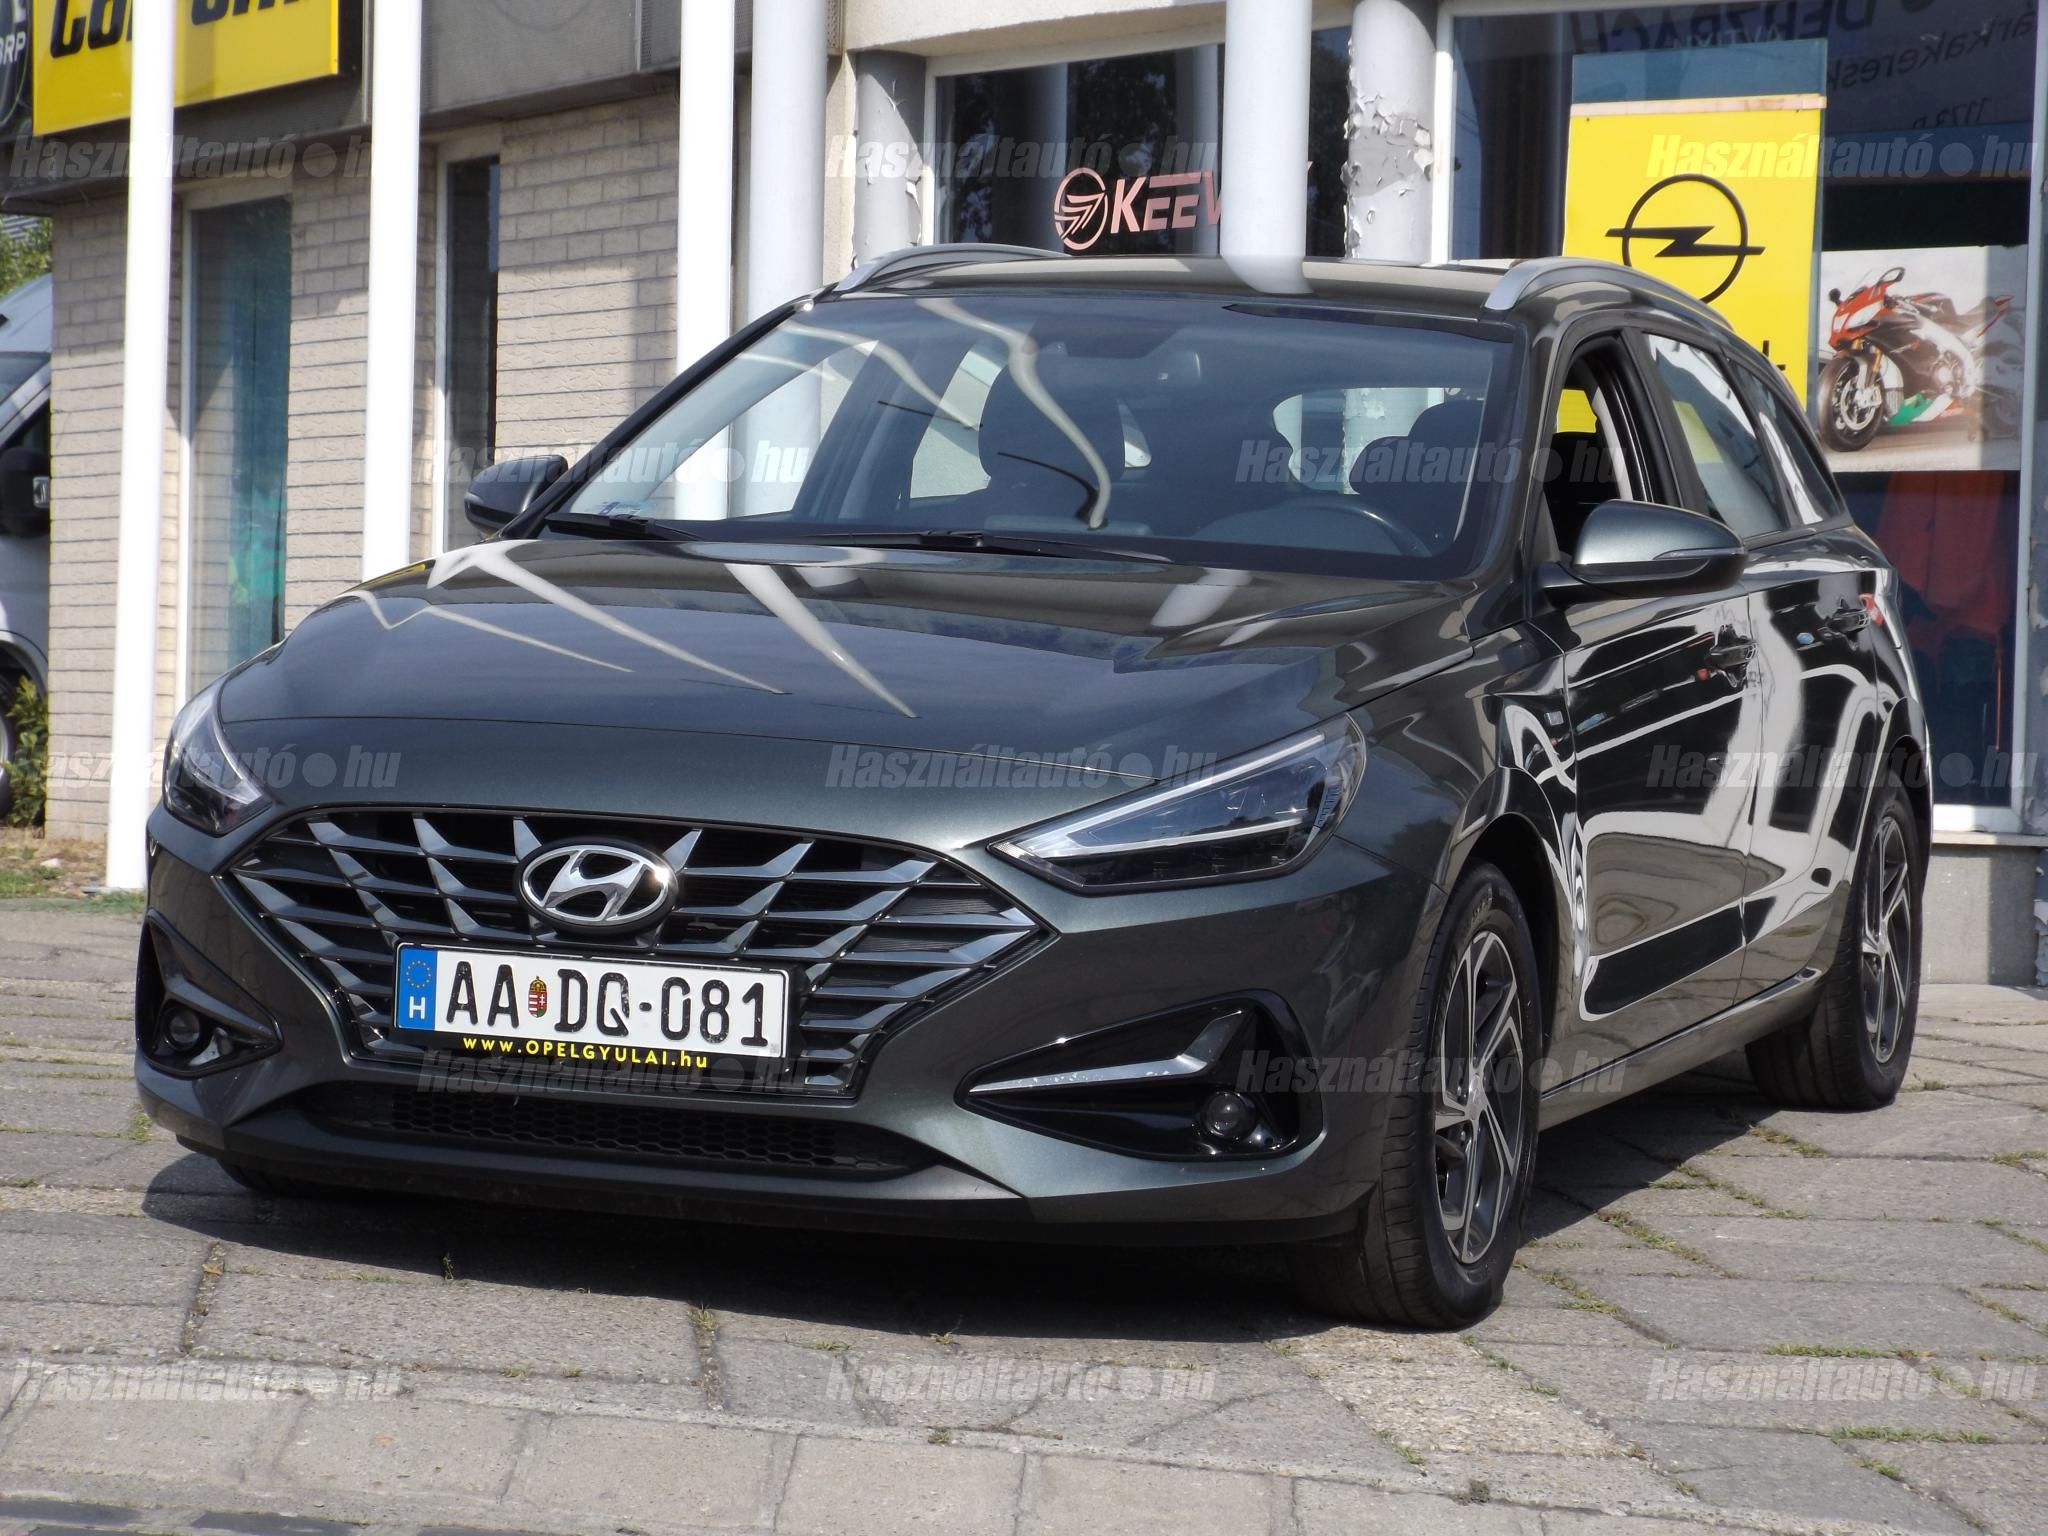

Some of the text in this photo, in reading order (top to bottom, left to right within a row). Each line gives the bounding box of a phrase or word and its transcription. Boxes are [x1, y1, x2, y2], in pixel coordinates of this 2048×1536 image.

[408, 996, 426, 1020] H
[446, 960, 769, 1047] AA DQ-081
[463, 1037, 709, 1068] www.OPELGYULAI.hu
